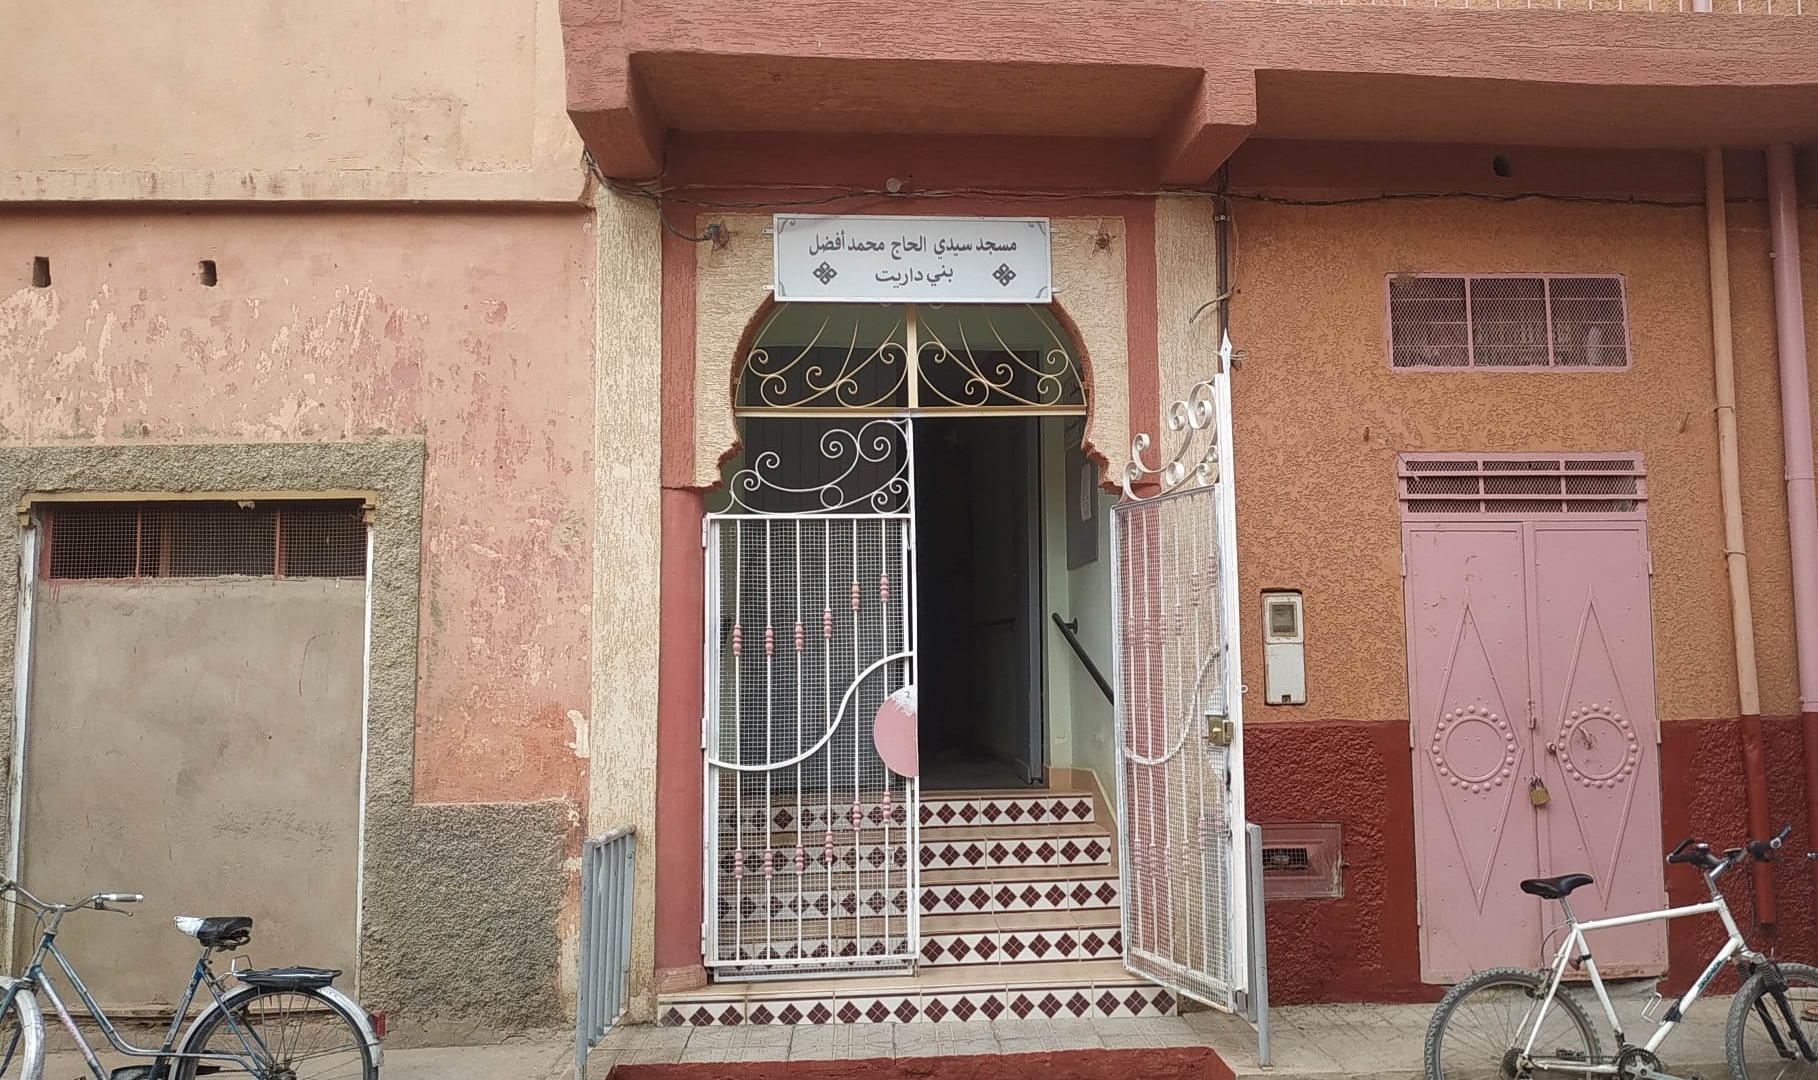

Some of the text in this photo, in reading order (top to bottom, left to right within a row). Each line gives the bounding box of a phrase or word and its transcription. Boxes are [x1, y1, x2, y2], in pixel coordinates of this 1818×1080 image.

[809, 230, 1017, 260] مسجد سيدي الحاج محمد أفضل
[875, 265, 954, 288] بني داريت
